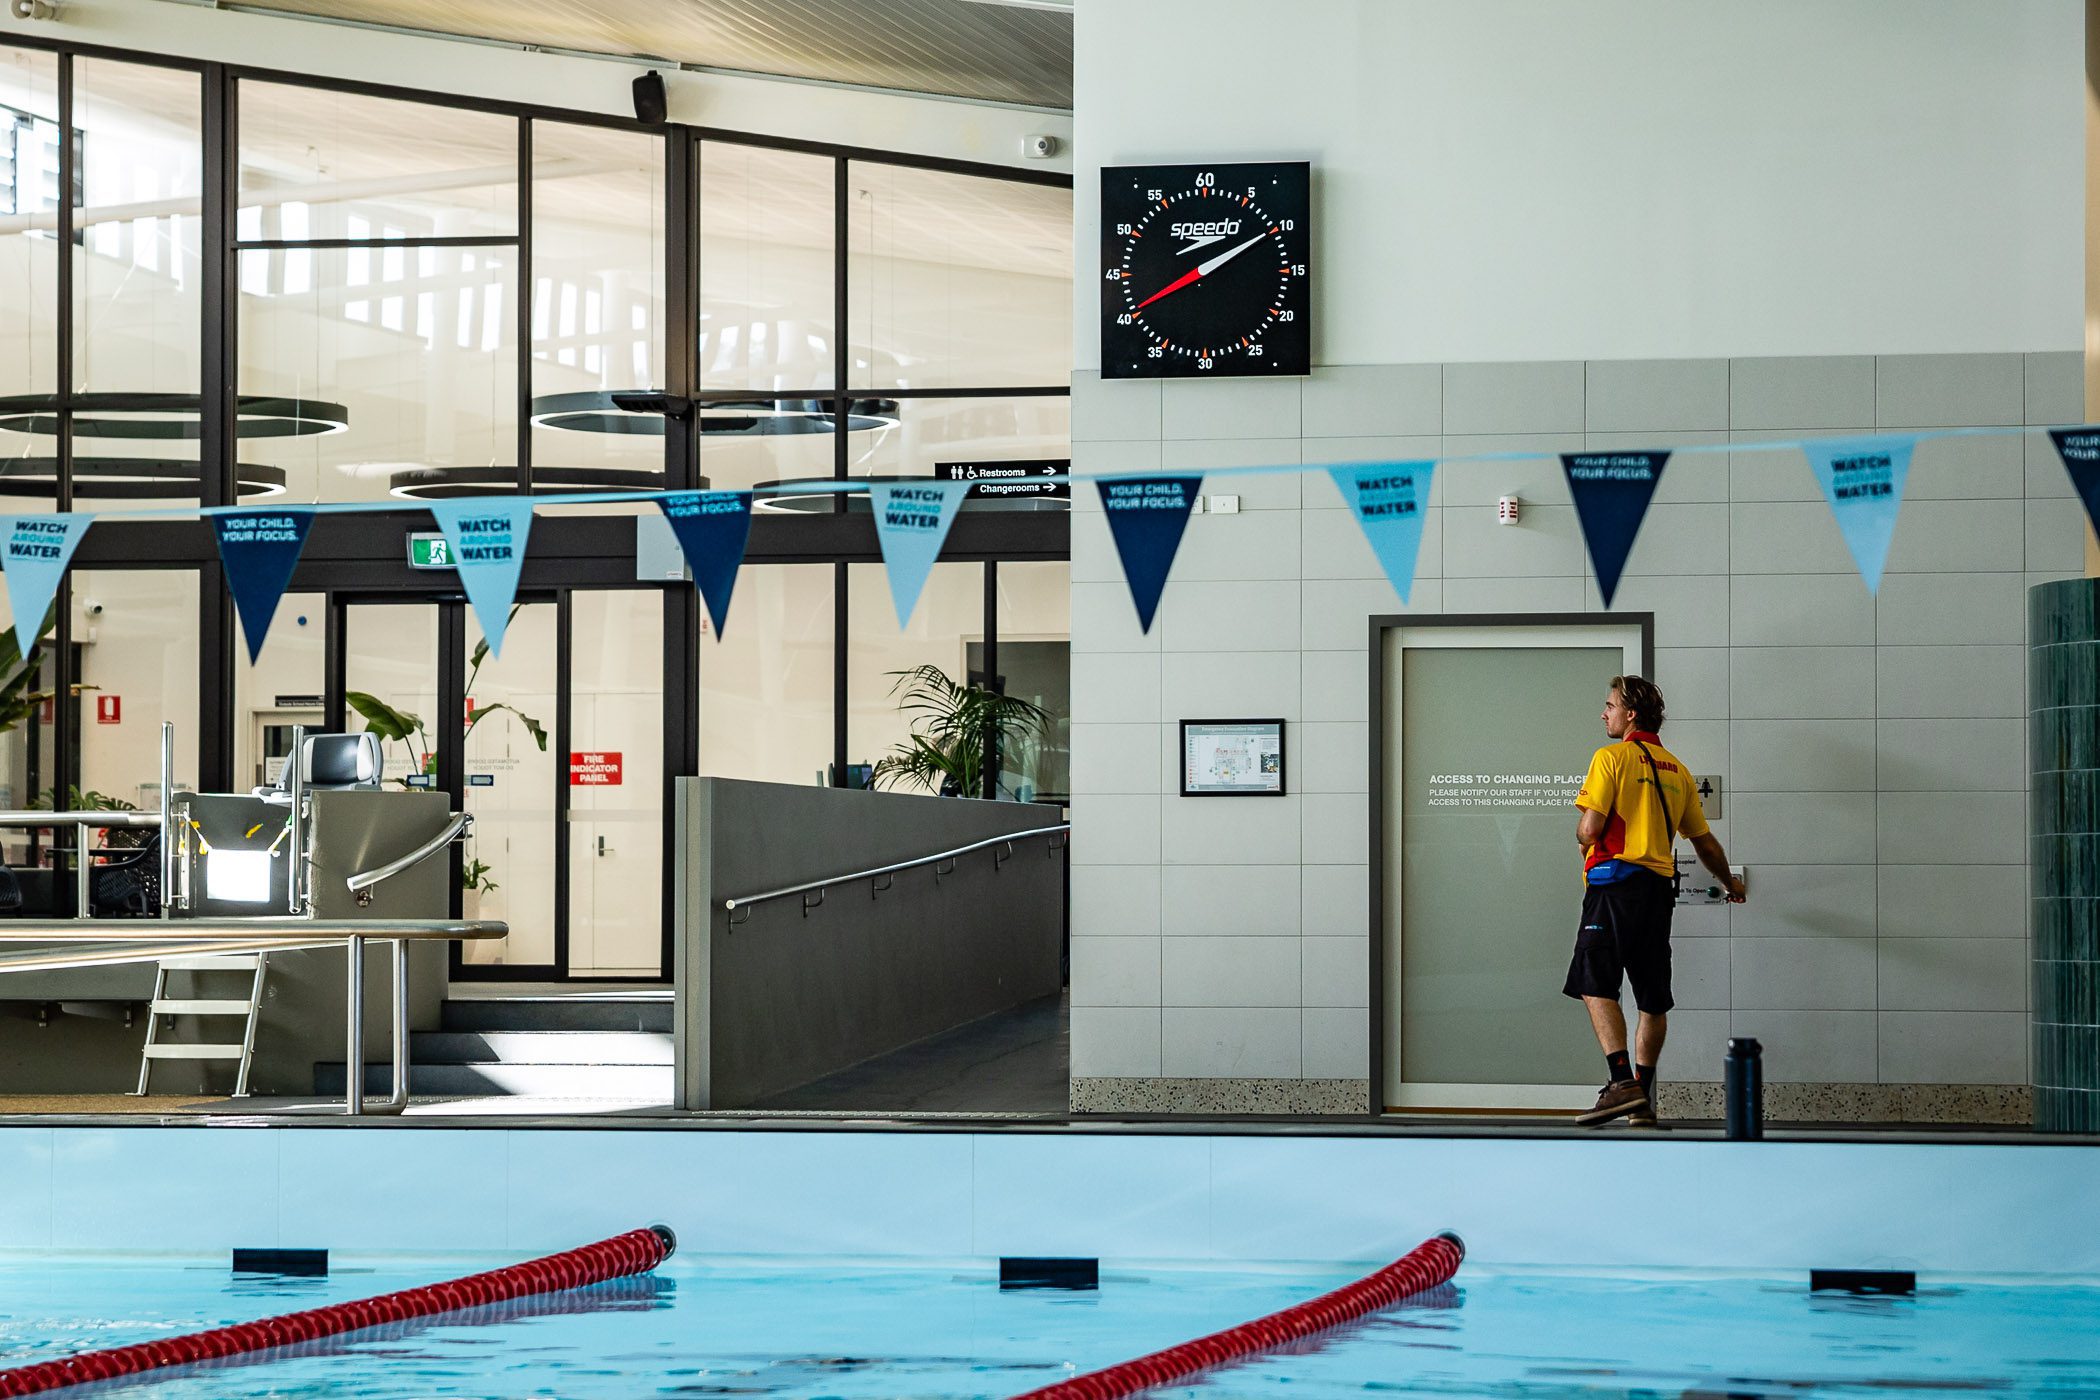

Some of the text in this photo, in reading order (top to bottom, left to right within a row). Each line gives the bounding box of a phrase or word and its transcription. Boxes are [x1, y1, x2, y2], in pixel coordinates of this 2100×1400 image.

[1195, 172, 1214, 187] 60
[1147, 189, 1162, 201] 55
[1248, 187, 1255, 198] 5
[1117, 223, 1131, 235] 50
[1171, 218, 1240, 240] speedo
[1279, 220, 1293, 231] 10
[1106, 269, 1120, 280] 45
[1291, 265, 1305, 276] 15
[1117, 314, 1132, 325] 40
[1279, 310, 1293, 322] 20
[1148, 347, 1162, 358] 35
[1248, 345, 1263, 356] 25
[1198, 358, 1212, 369] 30
[1831, 456, 1891, 472] WATCH
[979, 468, 1026, 478] Restrooms
[1571, 467, 1605, 479] YOUR
[979, 484, 1040, 494] Changerooms
[1356, 476, 1414, 490] WATCH
[890, 488, 944, 501] WATCH
[1109, 484, 1143, 496] YOUR
[1834, 483, 1893, 500] WATER
[887, 502, 942, 513] AROUND
[1106, 497, 1141, 509] YOUR
[1360, 501, 1417, 515] WATER
[667, 505, 701, 517] YOUR
[225, 518, 257, 529] YOUR
[458, 519, 512, 532] WATCH
[885, 512, 939, 528] WATER
[16, 521, 69, 534] WATCH
[11, 533, 65, 545] AROUND
[222, 531, 255, 541] YOUR
[10, 543, 61, 558] WATER
[461, 546, 512, 560] WATER
[583, 755, 605, 764] FIRE
[570, 764, 618, 773] INDICATOR
[580, 774, 609, 782] PANEL
[1429, 775, 1473, 784] ACCESS
[1475, 775, 1490, 784] TO
[1493, 775, 1551, 784] CHANGING
